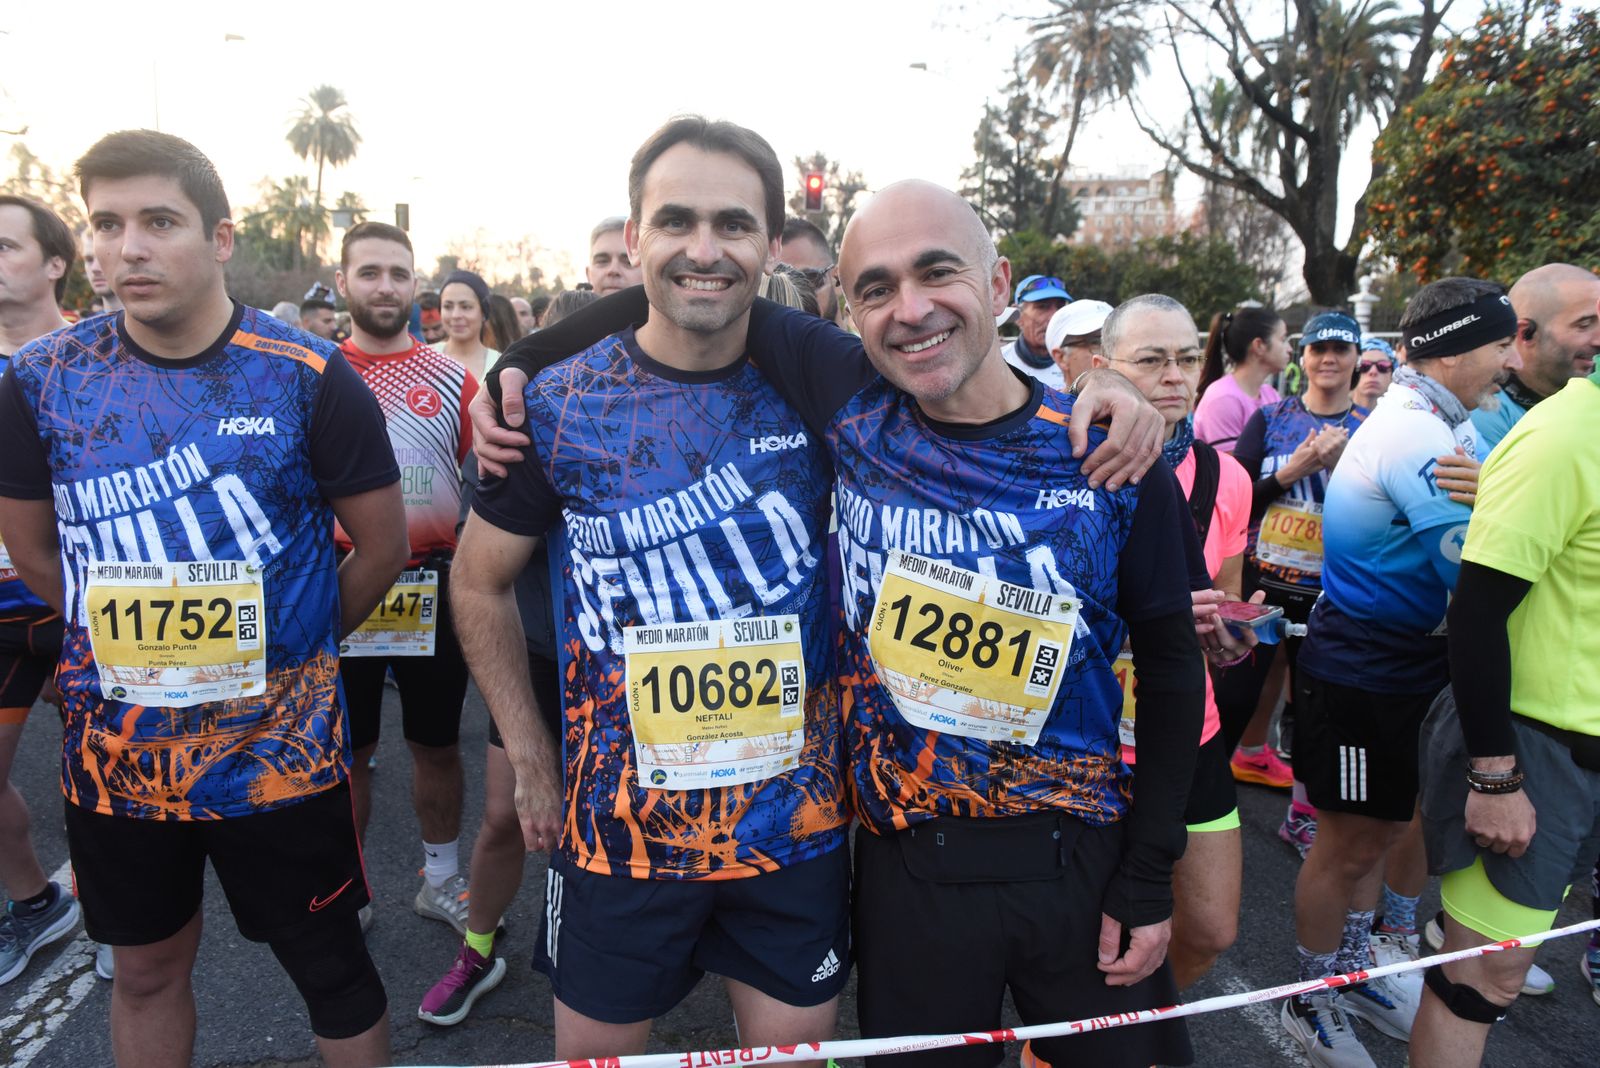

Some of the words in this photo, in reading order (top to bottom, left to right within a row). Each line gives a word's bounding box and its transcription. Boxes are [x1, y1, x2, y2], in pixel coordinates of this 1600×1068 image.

[1425, 314, 1482, 342] LURBEL
[216, 416, 276, 436] HOKA
[750, 431, 808, 455] HOKA
[75, 442, 210, 521] MARATÓN
[619, 461, 753, 552] MARATÓN
[1034, 488, 1095, 511] HOKA
[1271, 511, 1323, 542] 1078
[97, 566, 123, 580] MEDIO
[124, 564, 163, 580] MARATÓN
[188, 562, 238, 583] SEVILLA
[898, 553, 927, 576] MEDIO
[929, 564, 974, 592] MARATÓN
[996, 583, 1053, 616] SEVILLA
[380, 593, 422, 617] 147
[101, 597, 233, 641] 11752
[636, 629, 663, 645] MEDIO
[665, 623, 709, 643] MARATÓN
[733, 620, 779, 643] SEVILLA
[890, 594, 1032, 677] 12881
[137, 643, 171, 651] Gonzalo
[172, 643, 197, 651] Punta
[937, 658, 964, 674] Oliver
[642, 658, 780, 714] 10682
[919, 672, 939, 684] Perez
[940, 679, 973, 694] Gonzalez
[164, 691, 189, 699] HOKA
[695, 713, 733, 723] NEFTALI
[929, 712, 957, 727] HOKA
[686, 733, 719, 741] González
[720, 731, 744, 739] Acosta
[710, 767, 737, 779] HOKA
[912, 1039, 939, 1051] Creativa
